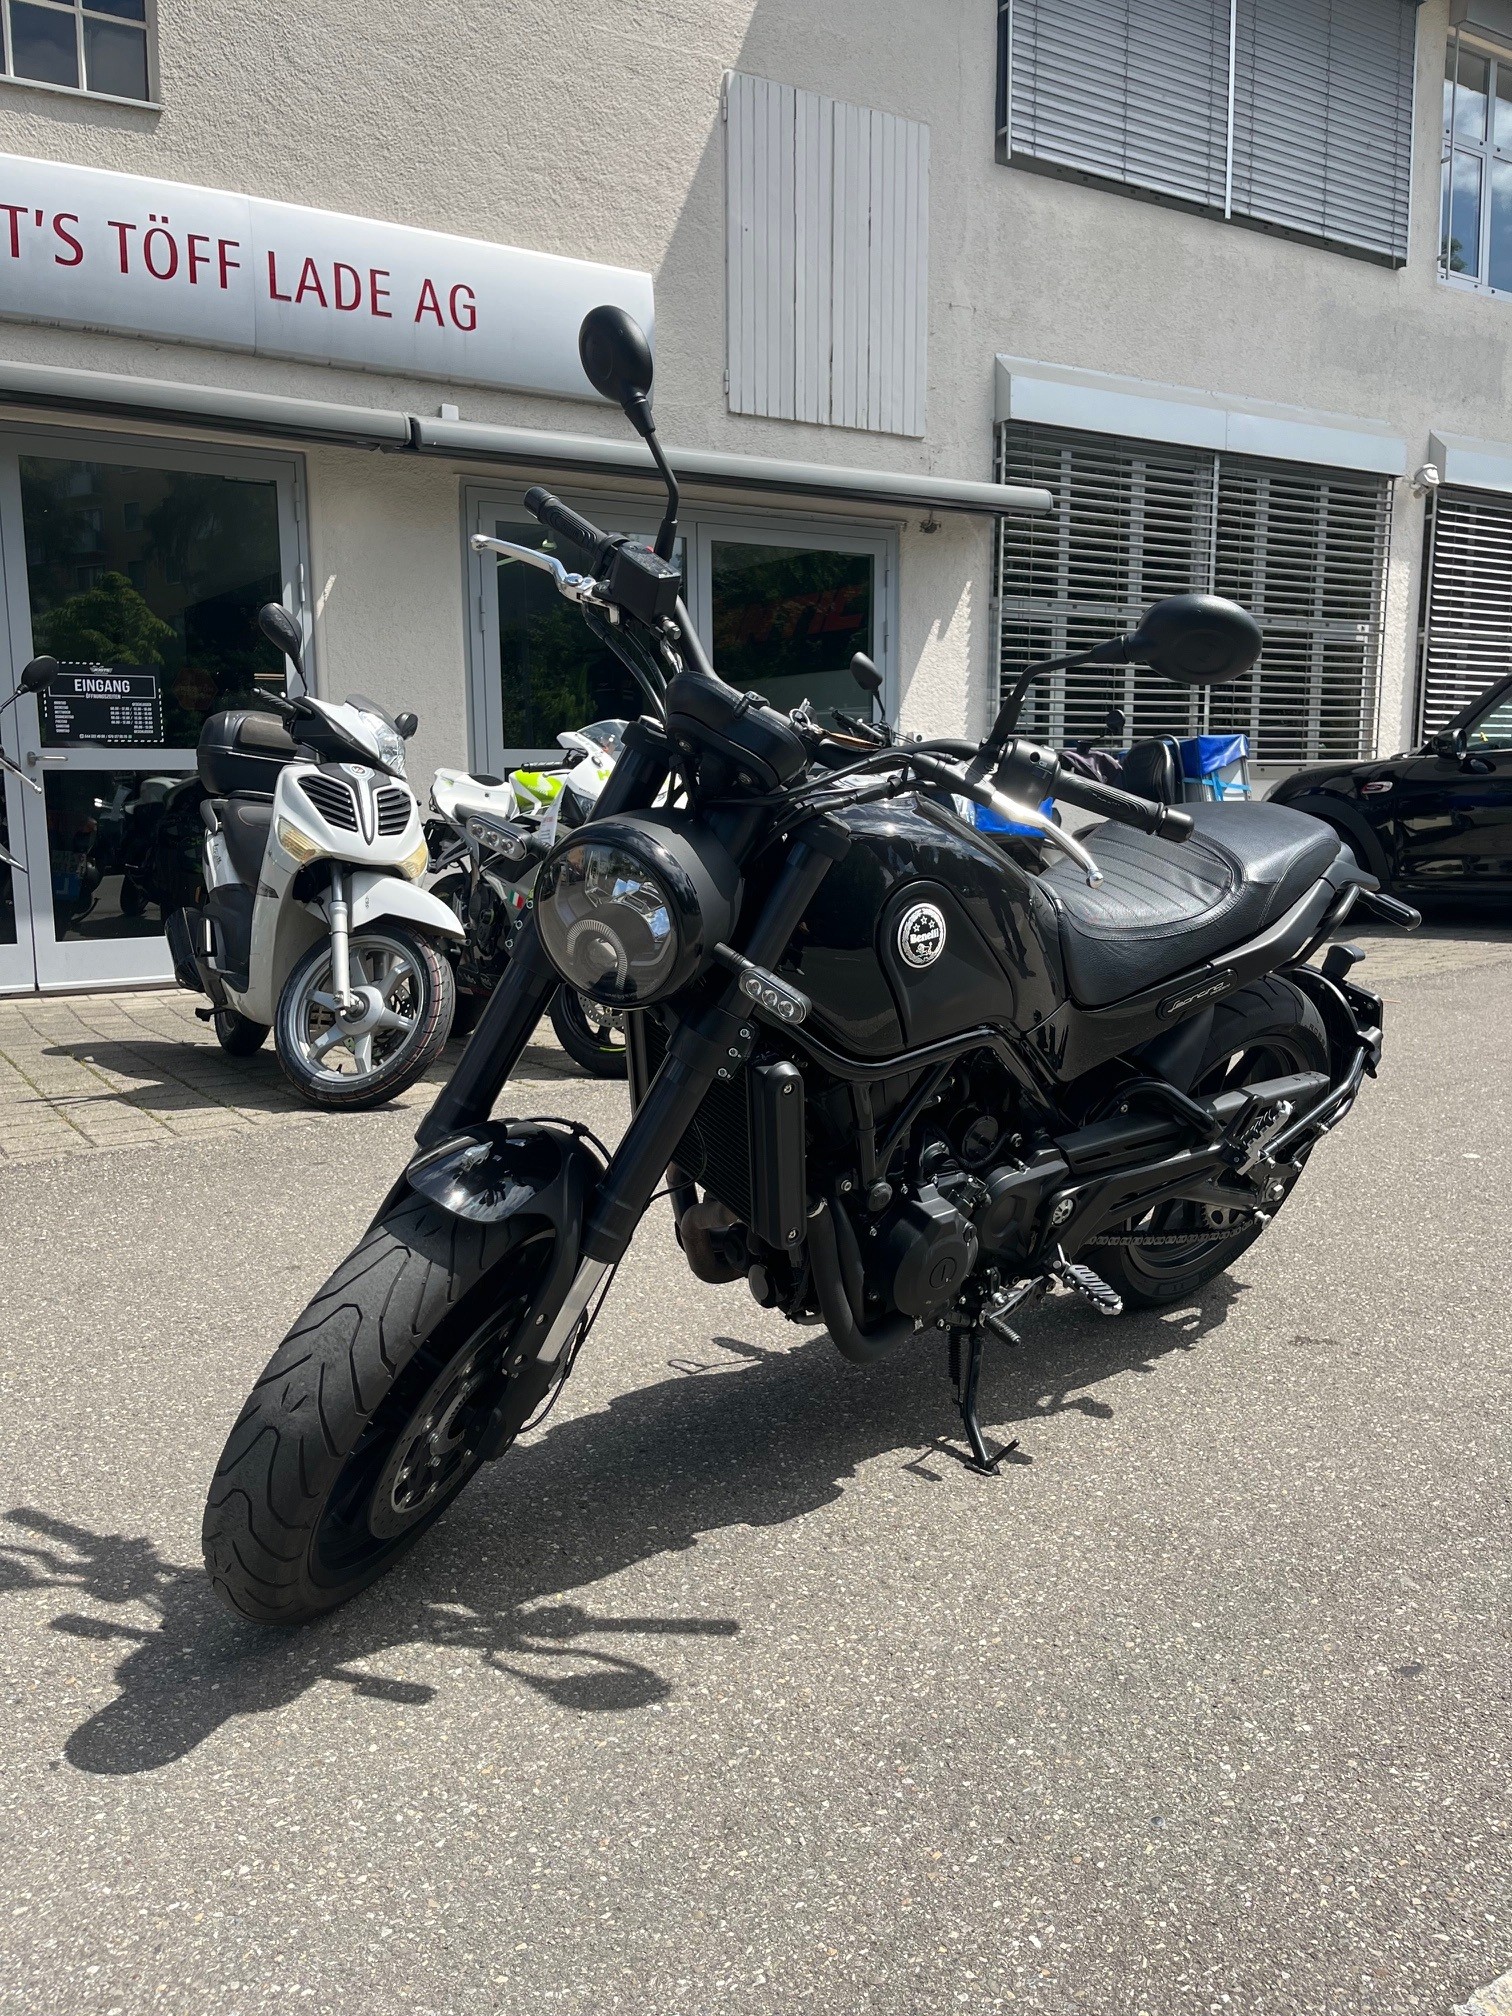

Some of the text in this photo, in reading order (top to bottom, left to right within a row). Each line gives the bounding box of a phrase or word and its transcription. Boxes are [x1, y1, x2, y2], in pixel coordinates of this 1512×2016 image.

[0, 204, 477, 332] T'S TÖFF LADE AG
[74, 678, 130, 693] EINGANG
[909, 927, 940, 944] Benelli
